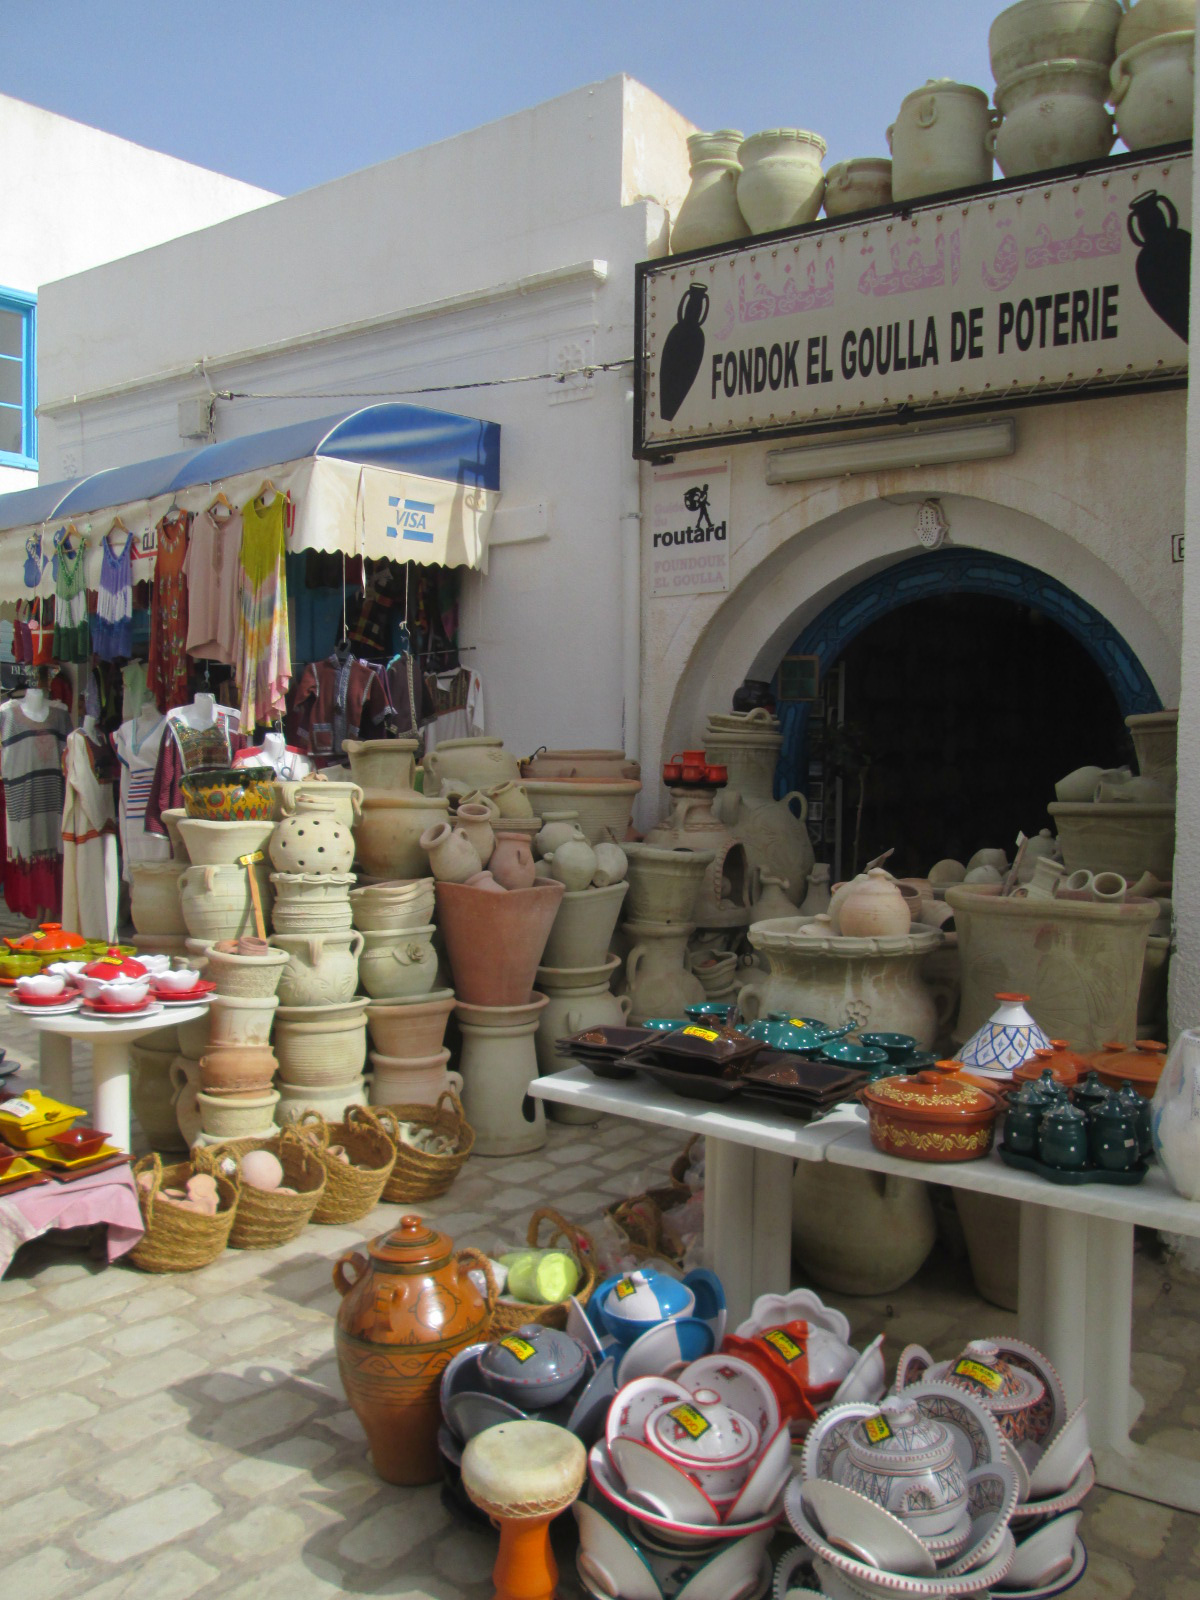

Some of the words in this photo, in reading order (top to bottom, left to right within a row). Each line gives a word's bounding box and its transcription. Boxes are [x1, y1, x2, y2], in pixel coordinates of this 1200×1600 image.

[981, 194, 1122, 292] فندق
[857, 228, 961, 297] القلة
[711, 339, 800, 400] FONDOK
[806, 335, 834, 386] EL
[841, 315, 939, 380] GOULLA
[950, 307, 984, 363] DE
[998, 284, 1119, 355] POTERIE
[396, 509, 426, 530] VISA
[653, 521, 726, 548] routard
[654, 554, 727, 574] FOUNDOUK
[654, 576, 670, 588] EL
[673, 571, 724, 587] GOULLA
